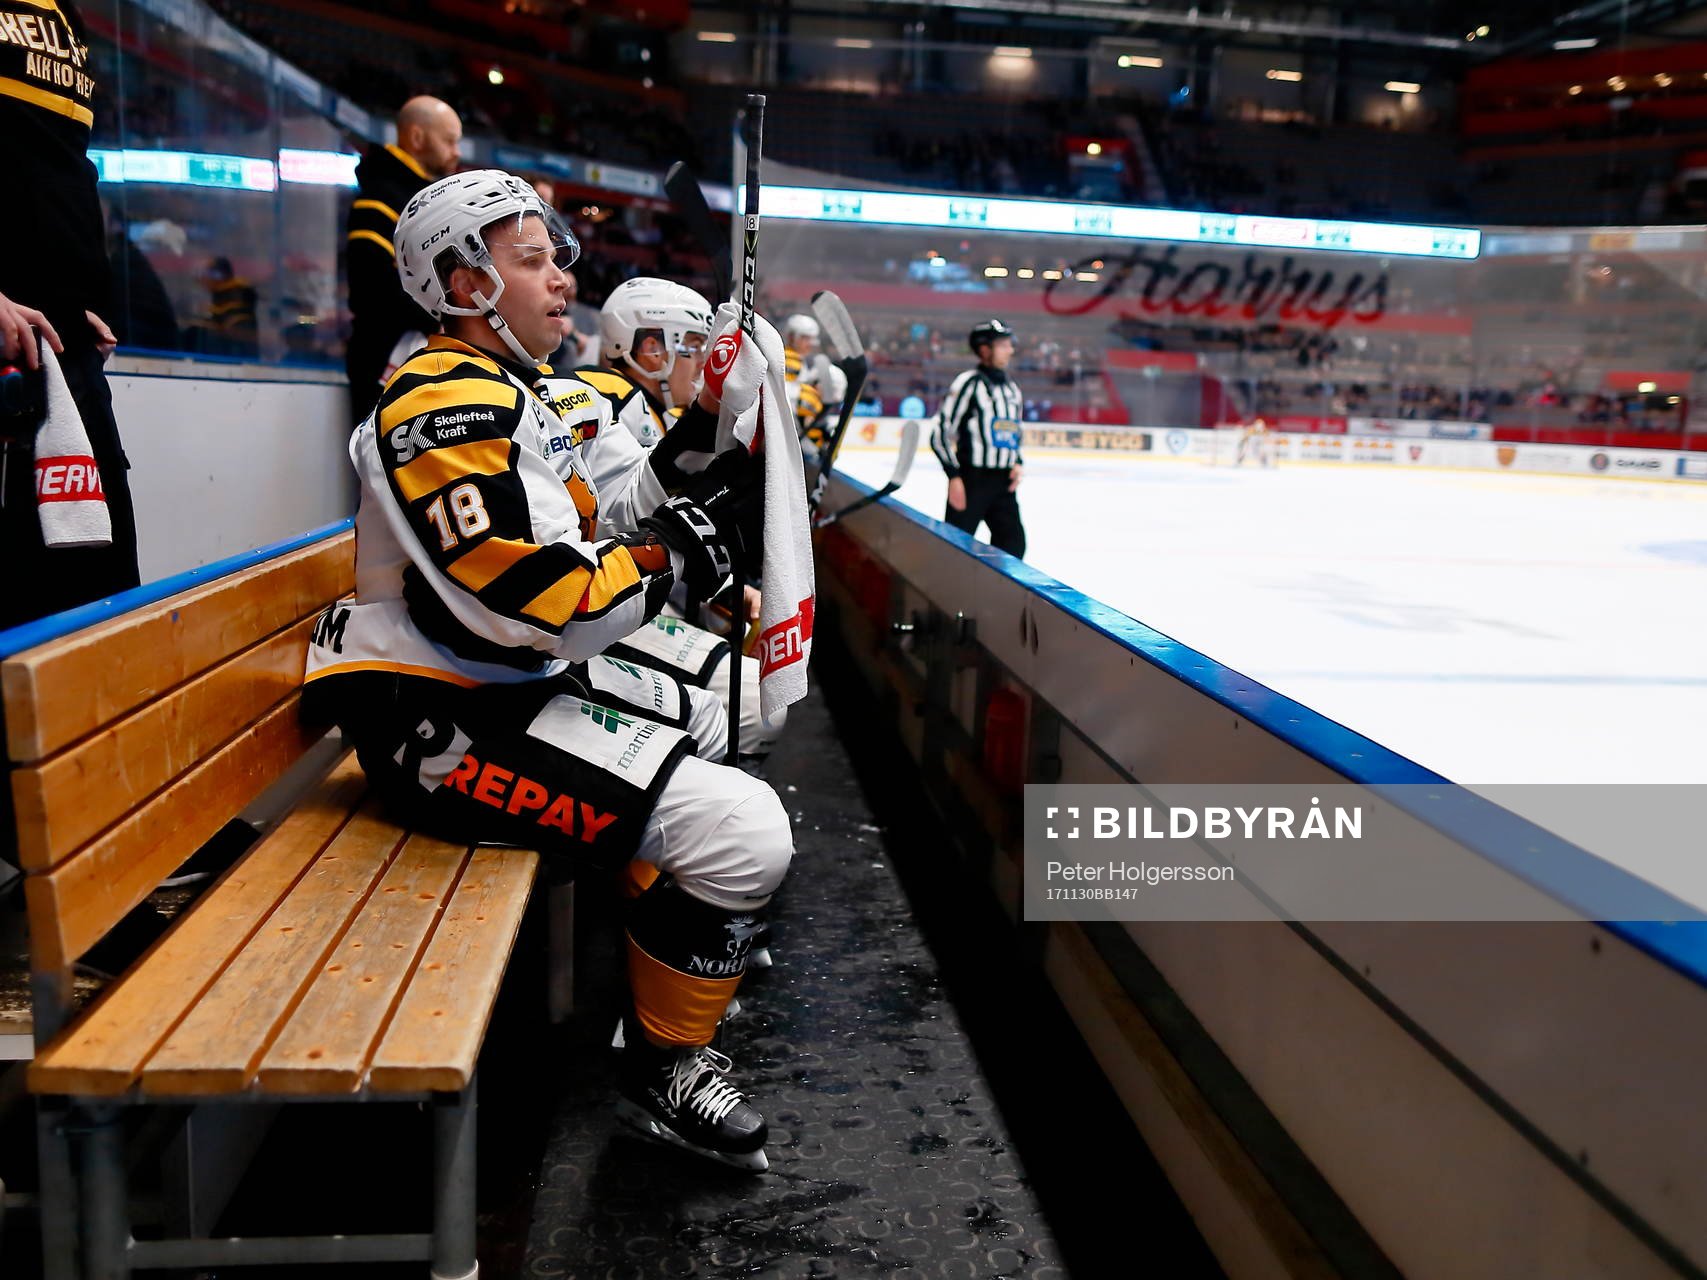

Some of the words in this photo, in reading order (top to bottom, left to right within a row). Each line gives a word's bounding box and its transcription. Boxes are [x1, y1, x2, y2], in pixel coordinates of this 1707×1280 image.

[421, 225, 451, 251] CCM
[1042, 244, 1391, 330] Harrys
[433, 410, 496, 428] Skellefteå
[435, 425, 468, 440] Kraft
[425, 483, 491, 551] 18
[443, 753, 618, 844] REPAY
